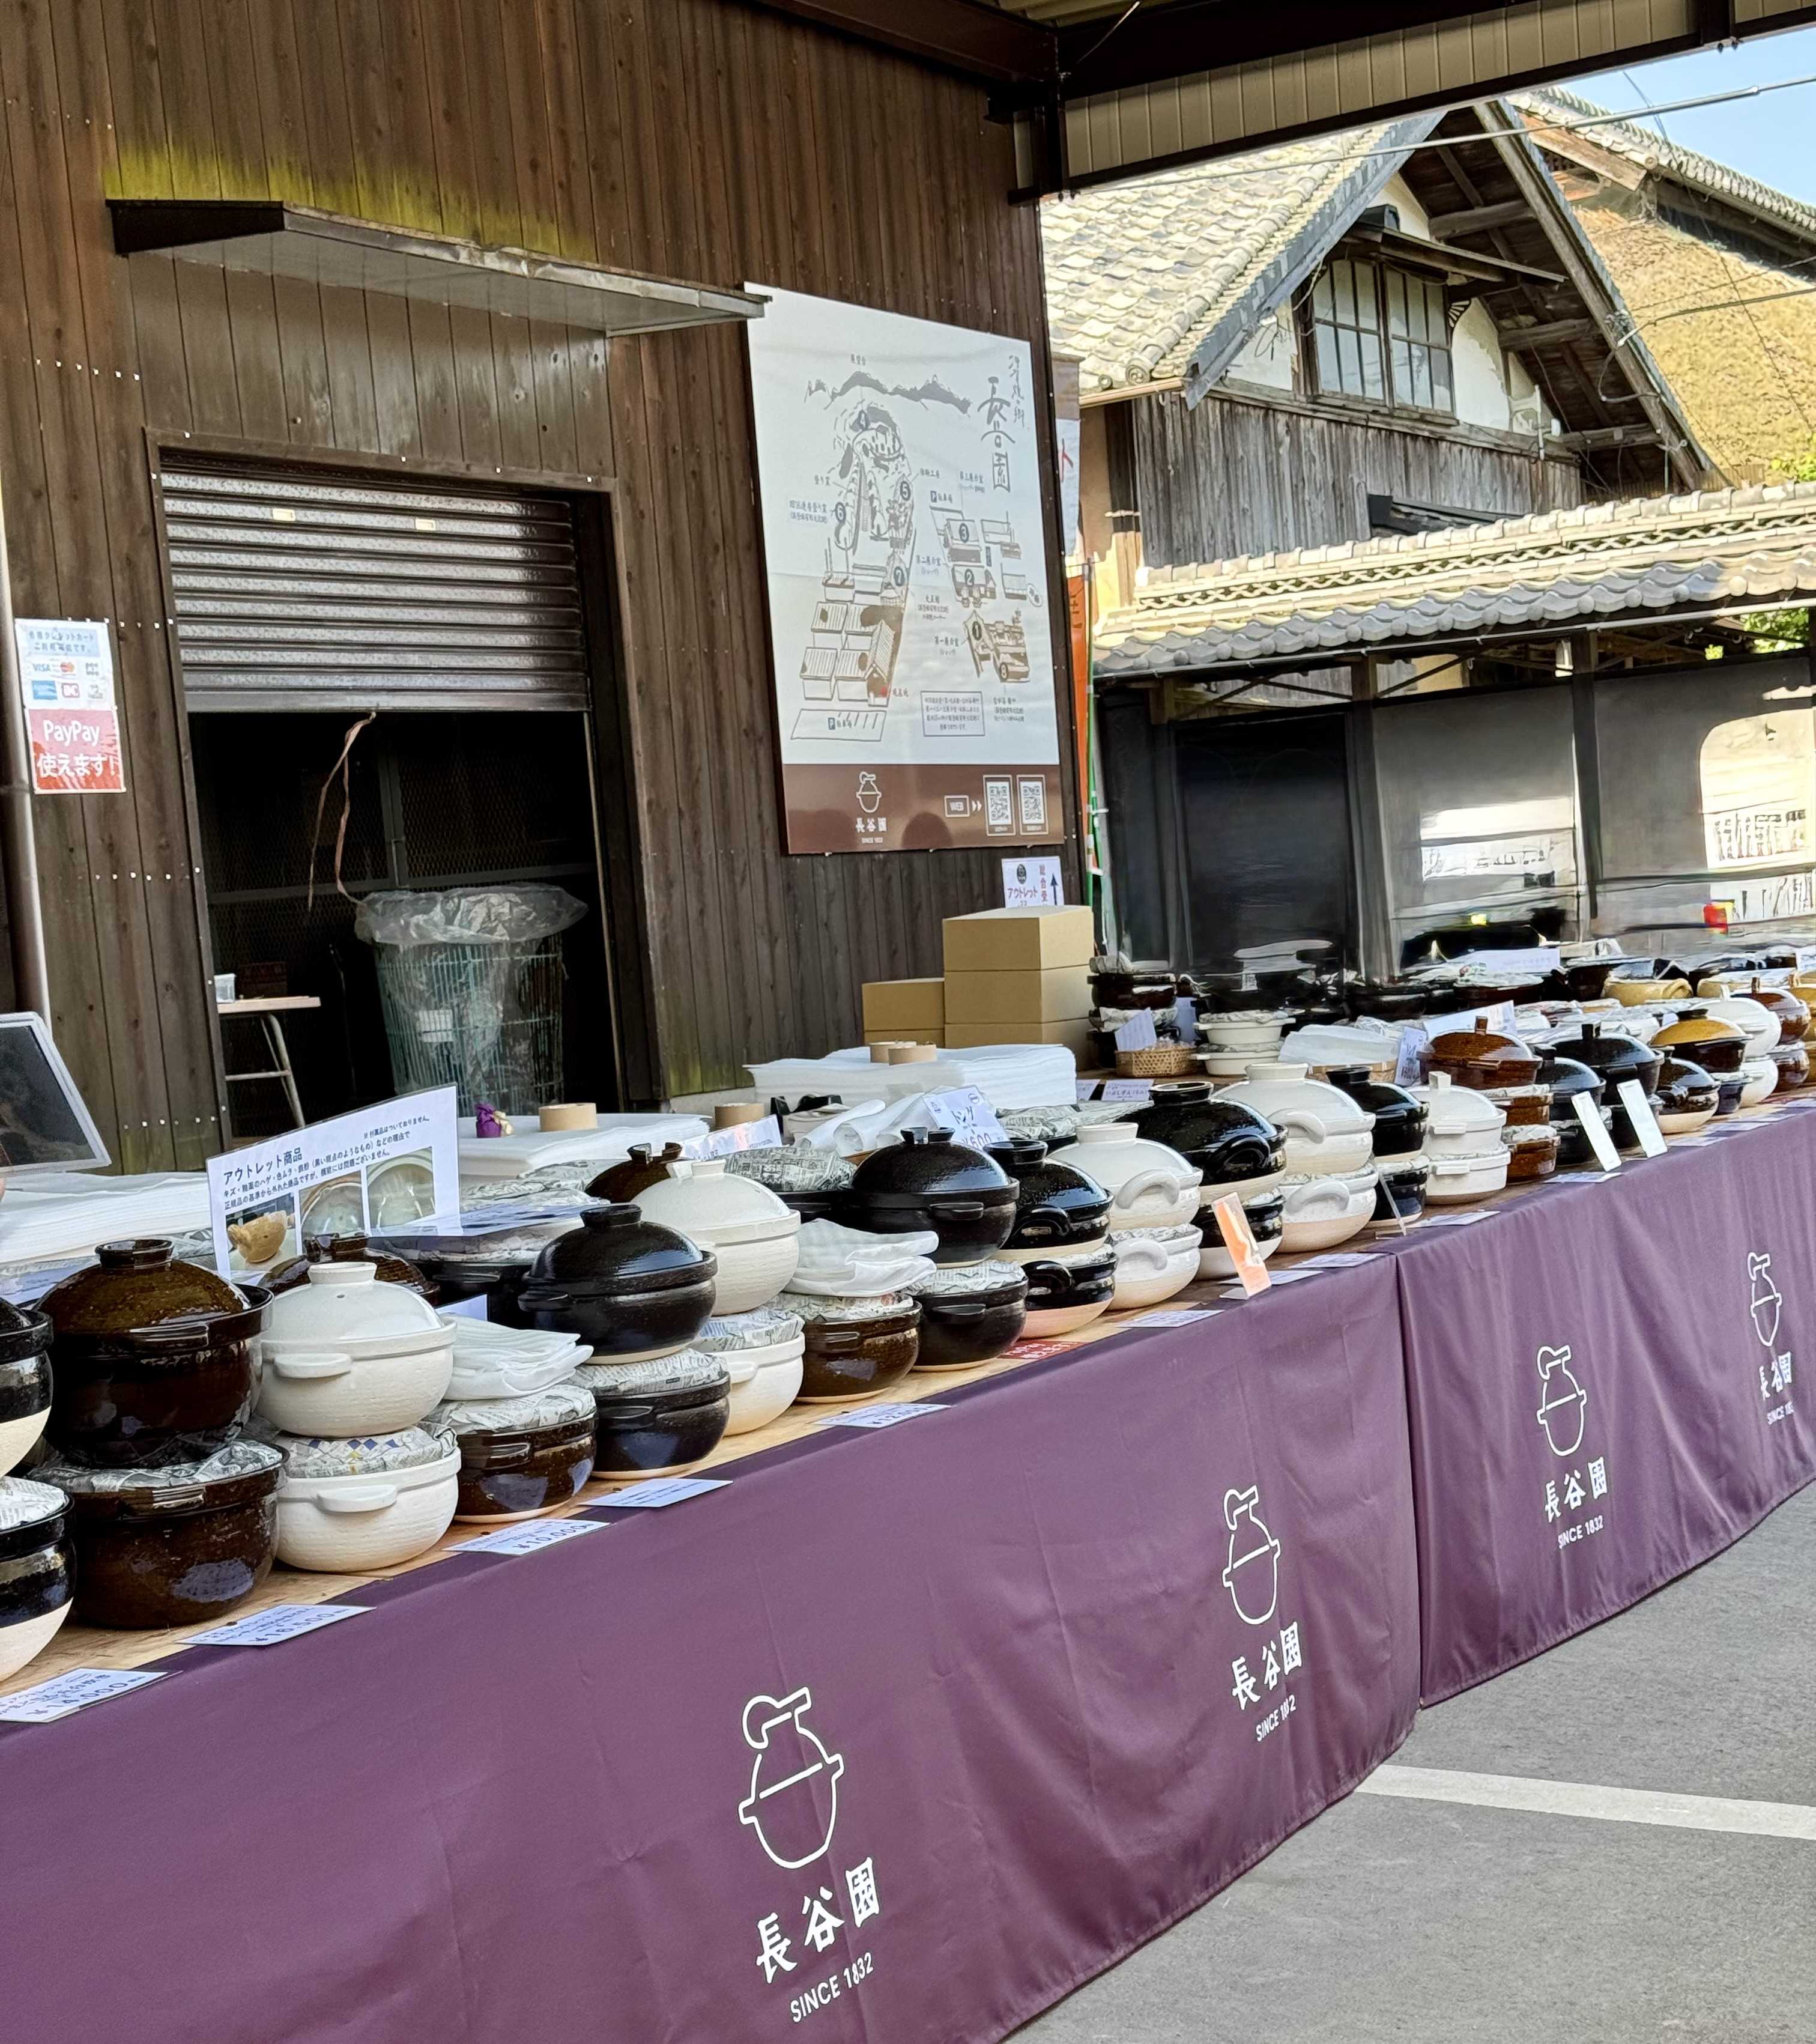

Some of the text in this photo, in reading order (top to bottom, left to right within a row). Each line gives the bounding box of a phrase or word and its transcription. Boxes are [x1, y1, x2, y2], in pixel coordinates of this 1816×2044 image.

[32, 663, 51, 672] VISA
[43, 720, 100, 747] PayPay
[1007, 886, 1038, 899] アウトレット
[1039, 864, 1048, 906] 総合受
[223, 1147, 303, 1186] アウトレット商品
[1545, 1456, 1608, 1523] 長谷園
[1231, 1621, 1303, 1711] 長谷園
[1255, 1709, 1279, 1742] SINCE
[755, 1856, 880, 1984] 長谷園
[790, 1952, 874, 2023] SINCE 1832
